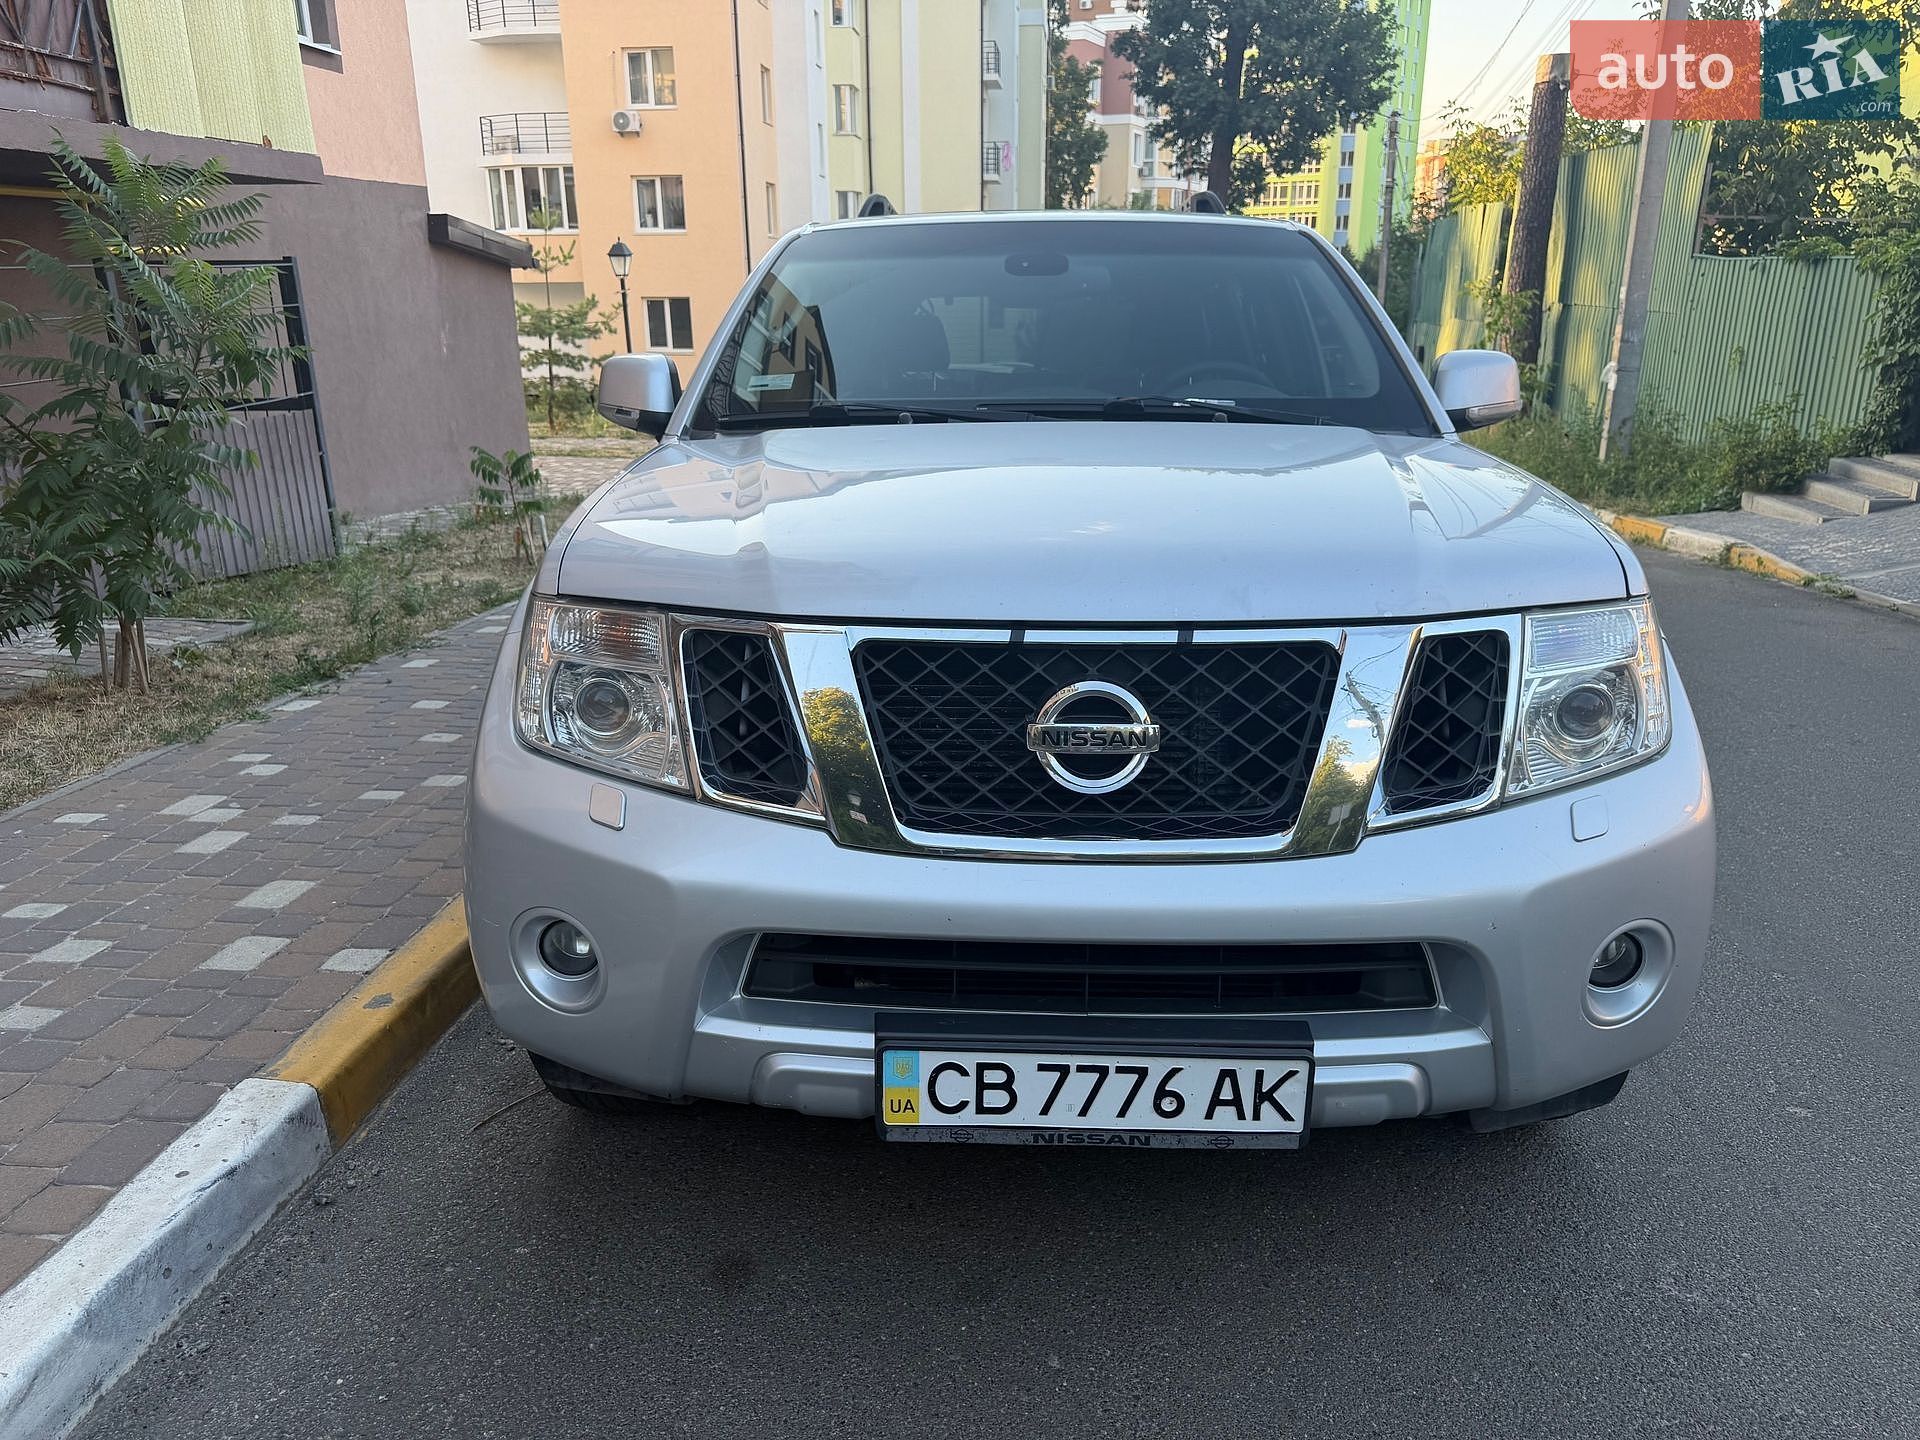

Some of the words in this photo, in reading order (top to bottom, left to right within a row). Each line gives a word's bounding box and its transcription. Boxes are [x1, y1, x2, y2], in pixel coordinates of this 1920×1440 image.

[1041, 730, 1147, 747] NISSAN
[927, 1061, 1018, 1115] CB
[1036, 1063, 1186, 1119] 7776
[1204, 1068, 1300, 1122] AK
[889, 1099, 916, 1114] UA
[1031, 1132, 1151, 1146] NISSAN
